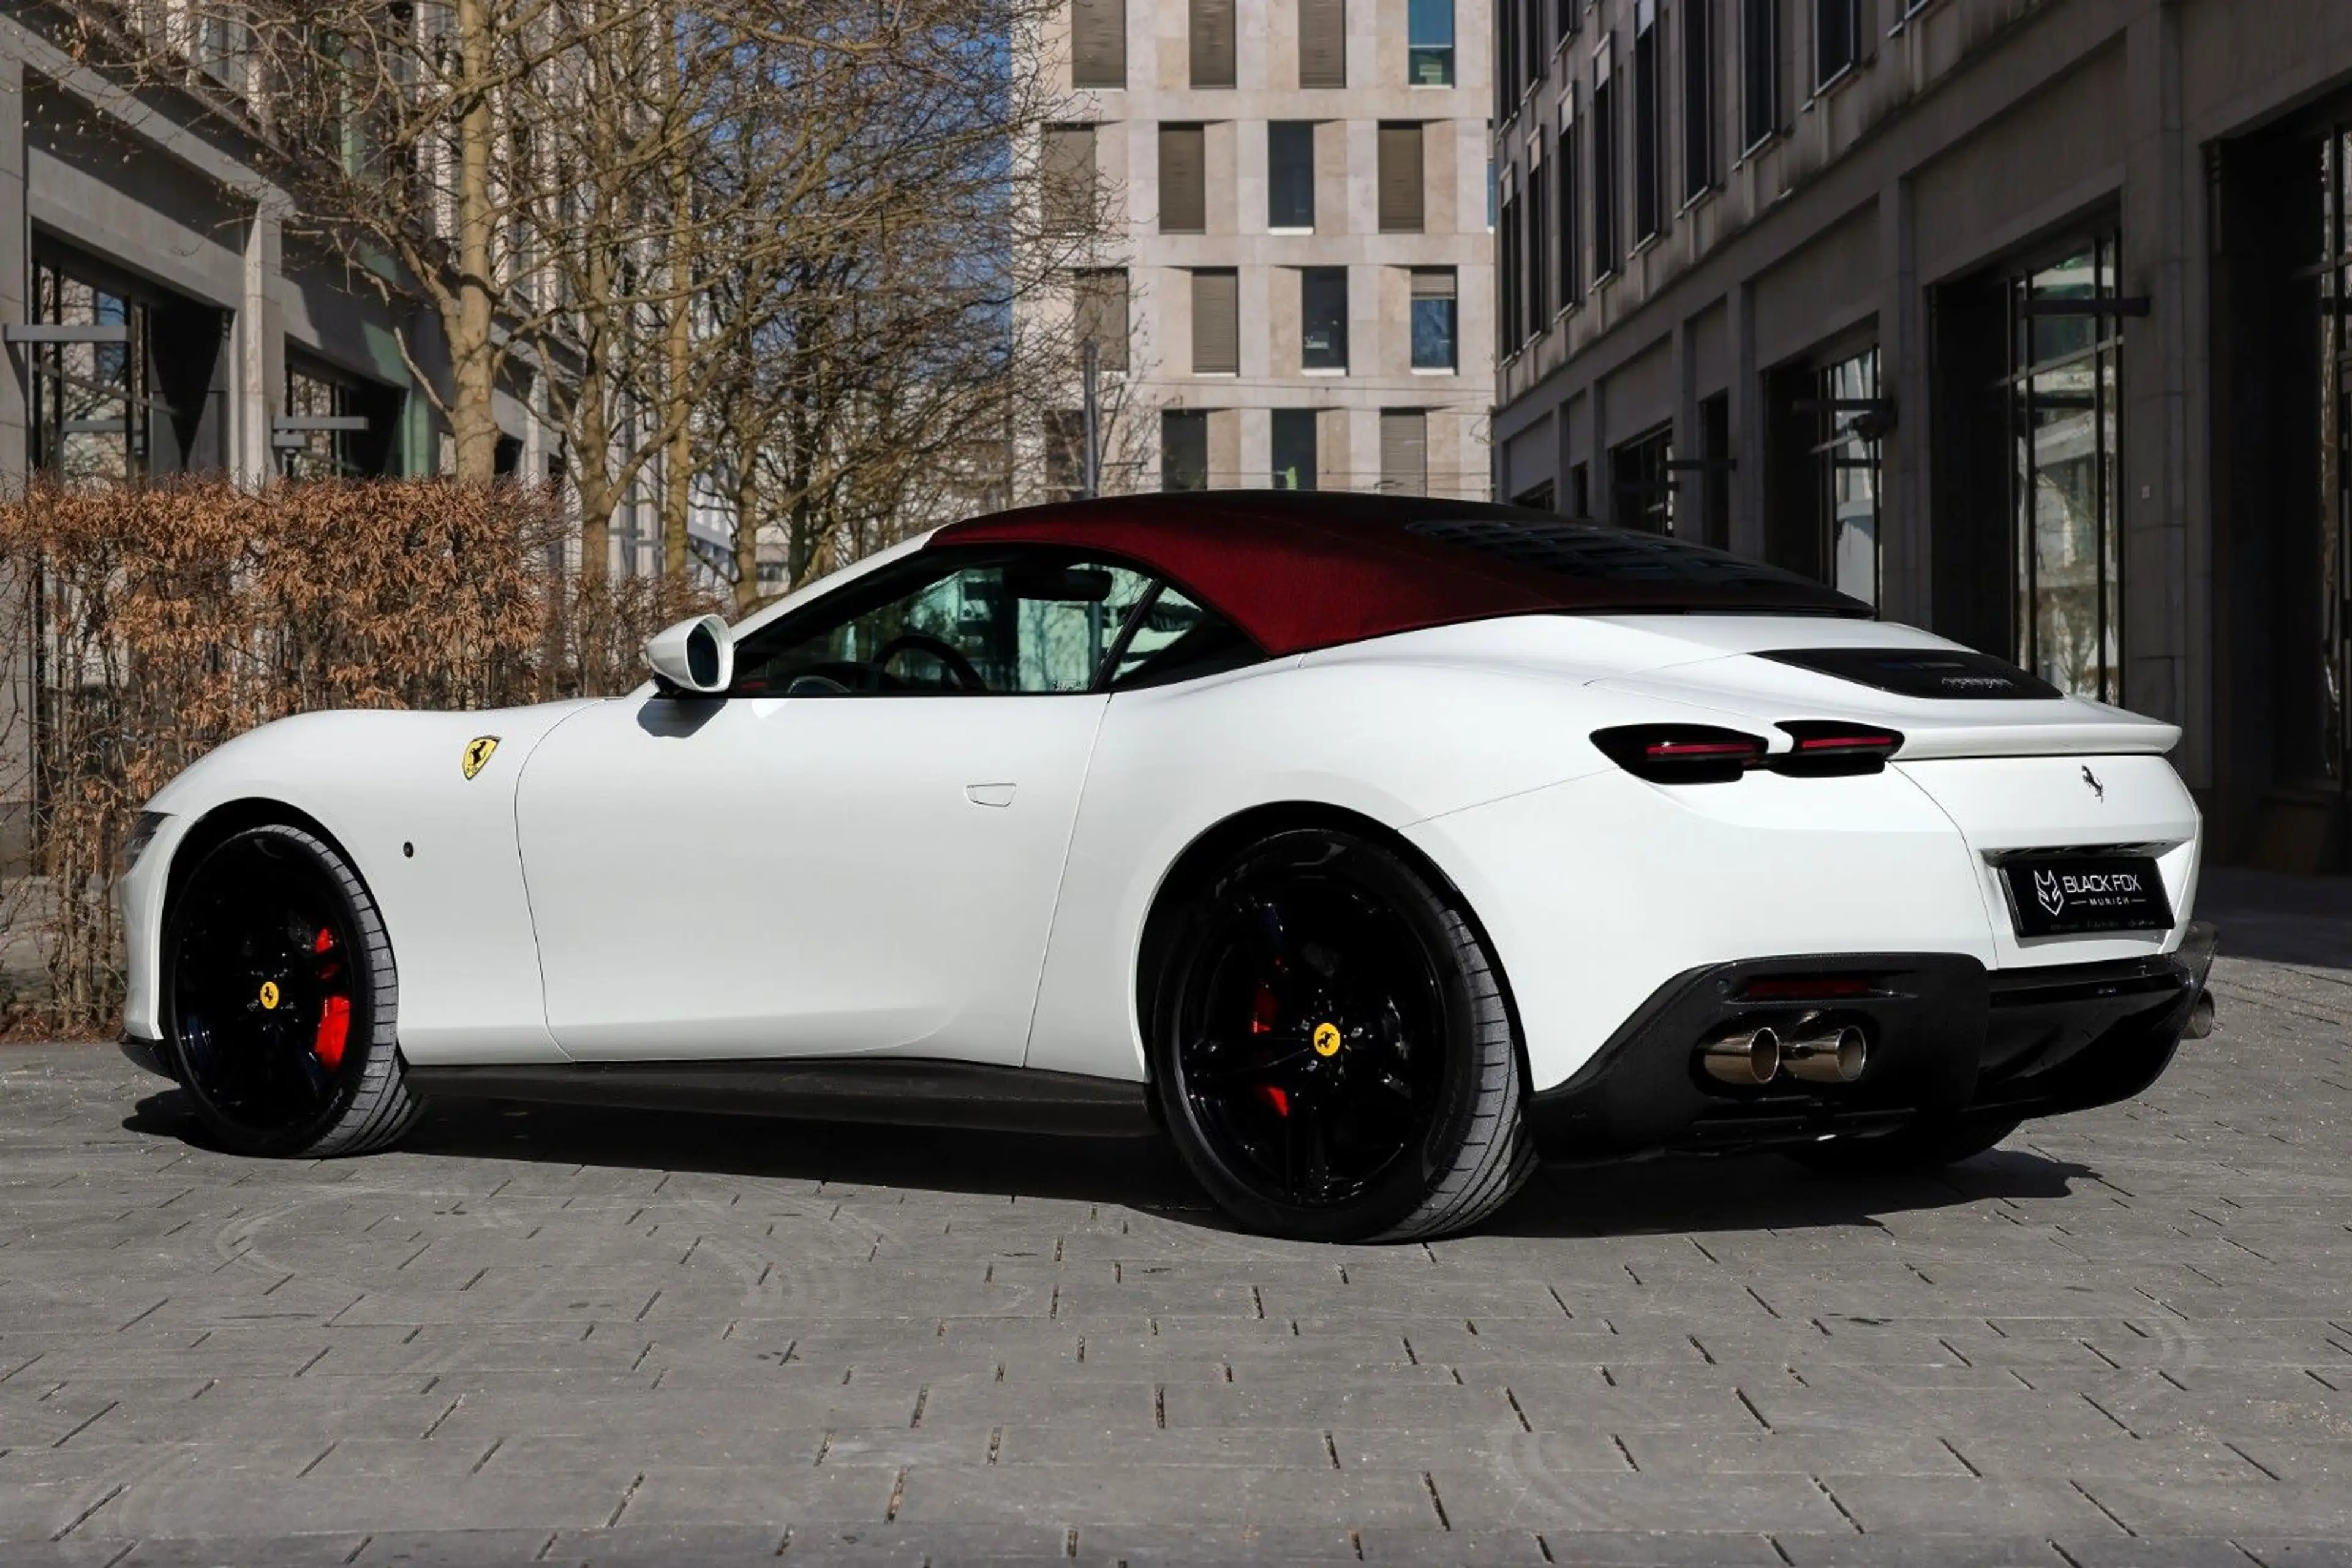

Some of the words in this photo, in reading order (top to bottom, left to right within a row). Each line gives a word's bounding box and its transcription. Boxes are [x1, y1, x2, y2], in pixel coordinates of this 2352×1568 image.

[2062, 875, 2113, 893] BLACK
[2112, 874, 2143, 891] FOX
[2089, 897, 2130, 906] MUNICH
